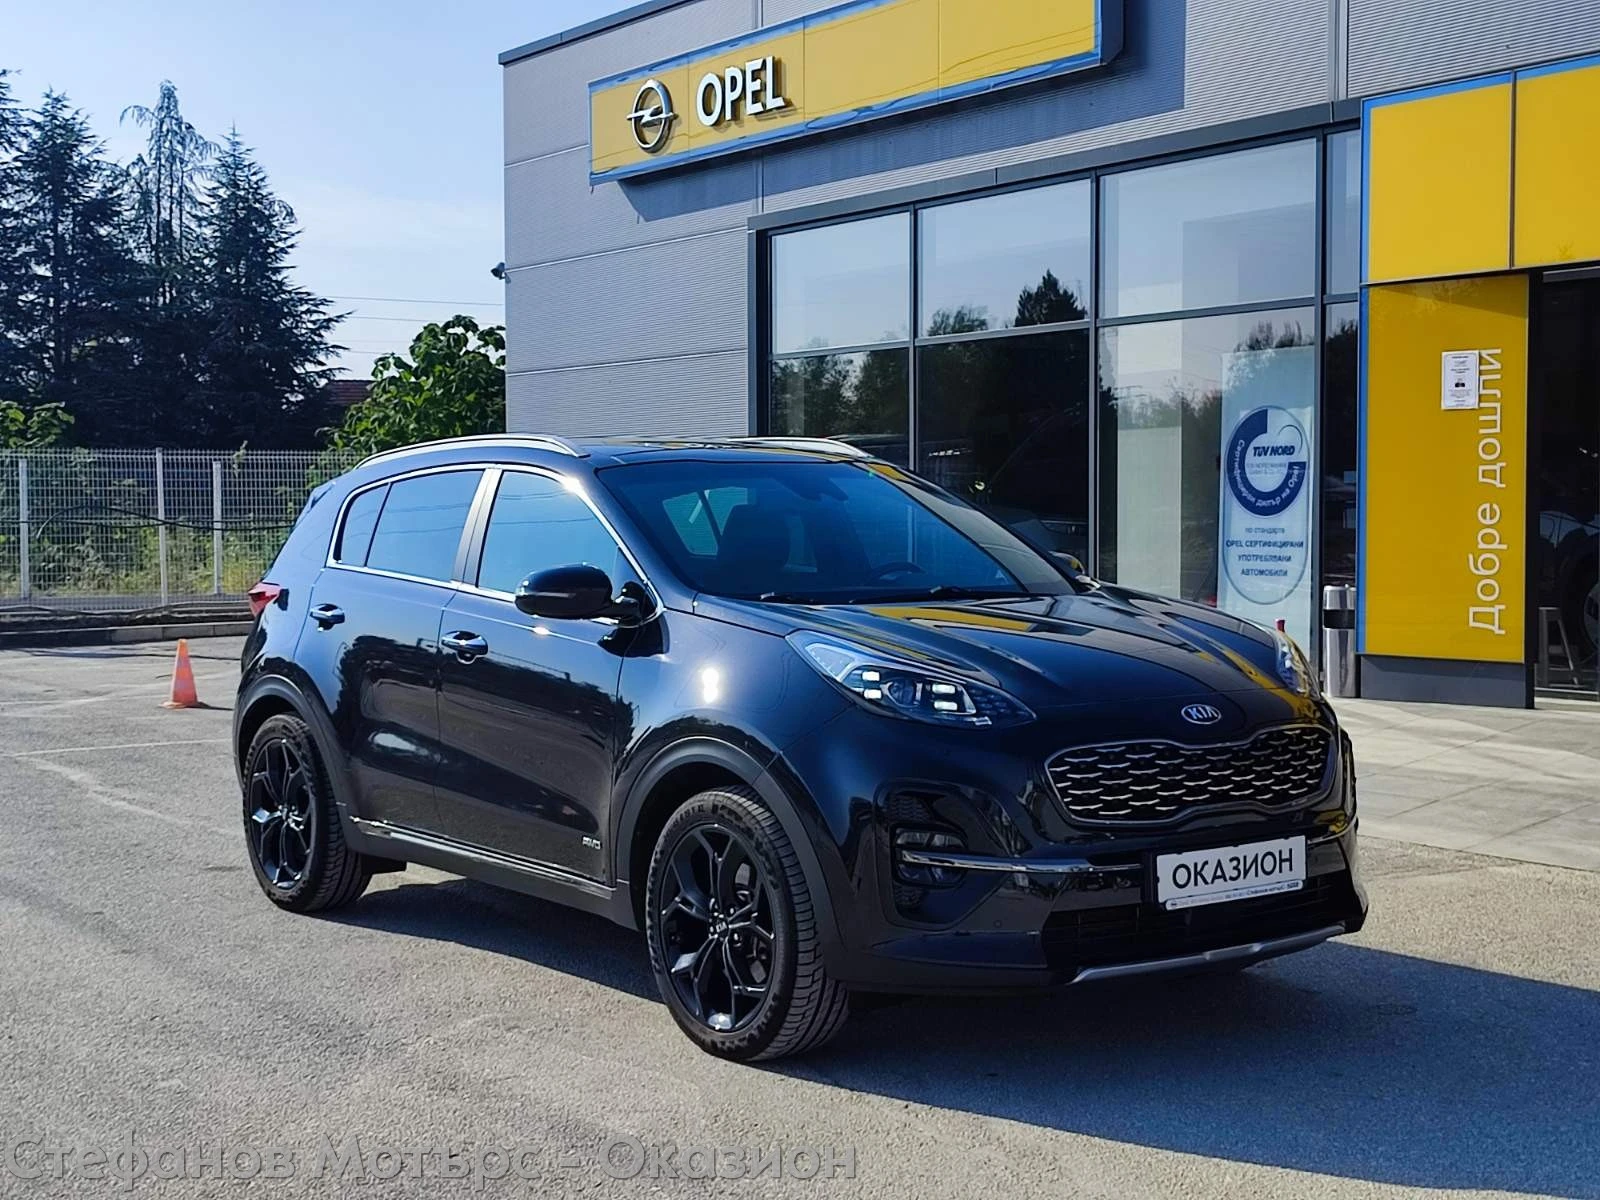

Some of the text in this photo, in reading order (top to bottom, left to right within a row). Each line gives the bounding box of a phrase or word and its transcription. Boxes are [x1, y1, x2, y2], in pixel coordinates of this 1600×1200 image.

[696, 55, 786, 127] OPEL
[1269, 445, 1296, 457] NORD
[1468, 348, 1508, 635] Добре дошли
[1226, 539, 1243, 548] OPEL
[1240, 568, 1288, 576] АВТОМОБИЛИ
[1186, 705, 1219, 720] KIA
[1172, 847, 1294, 890] ОКАЗИОН
